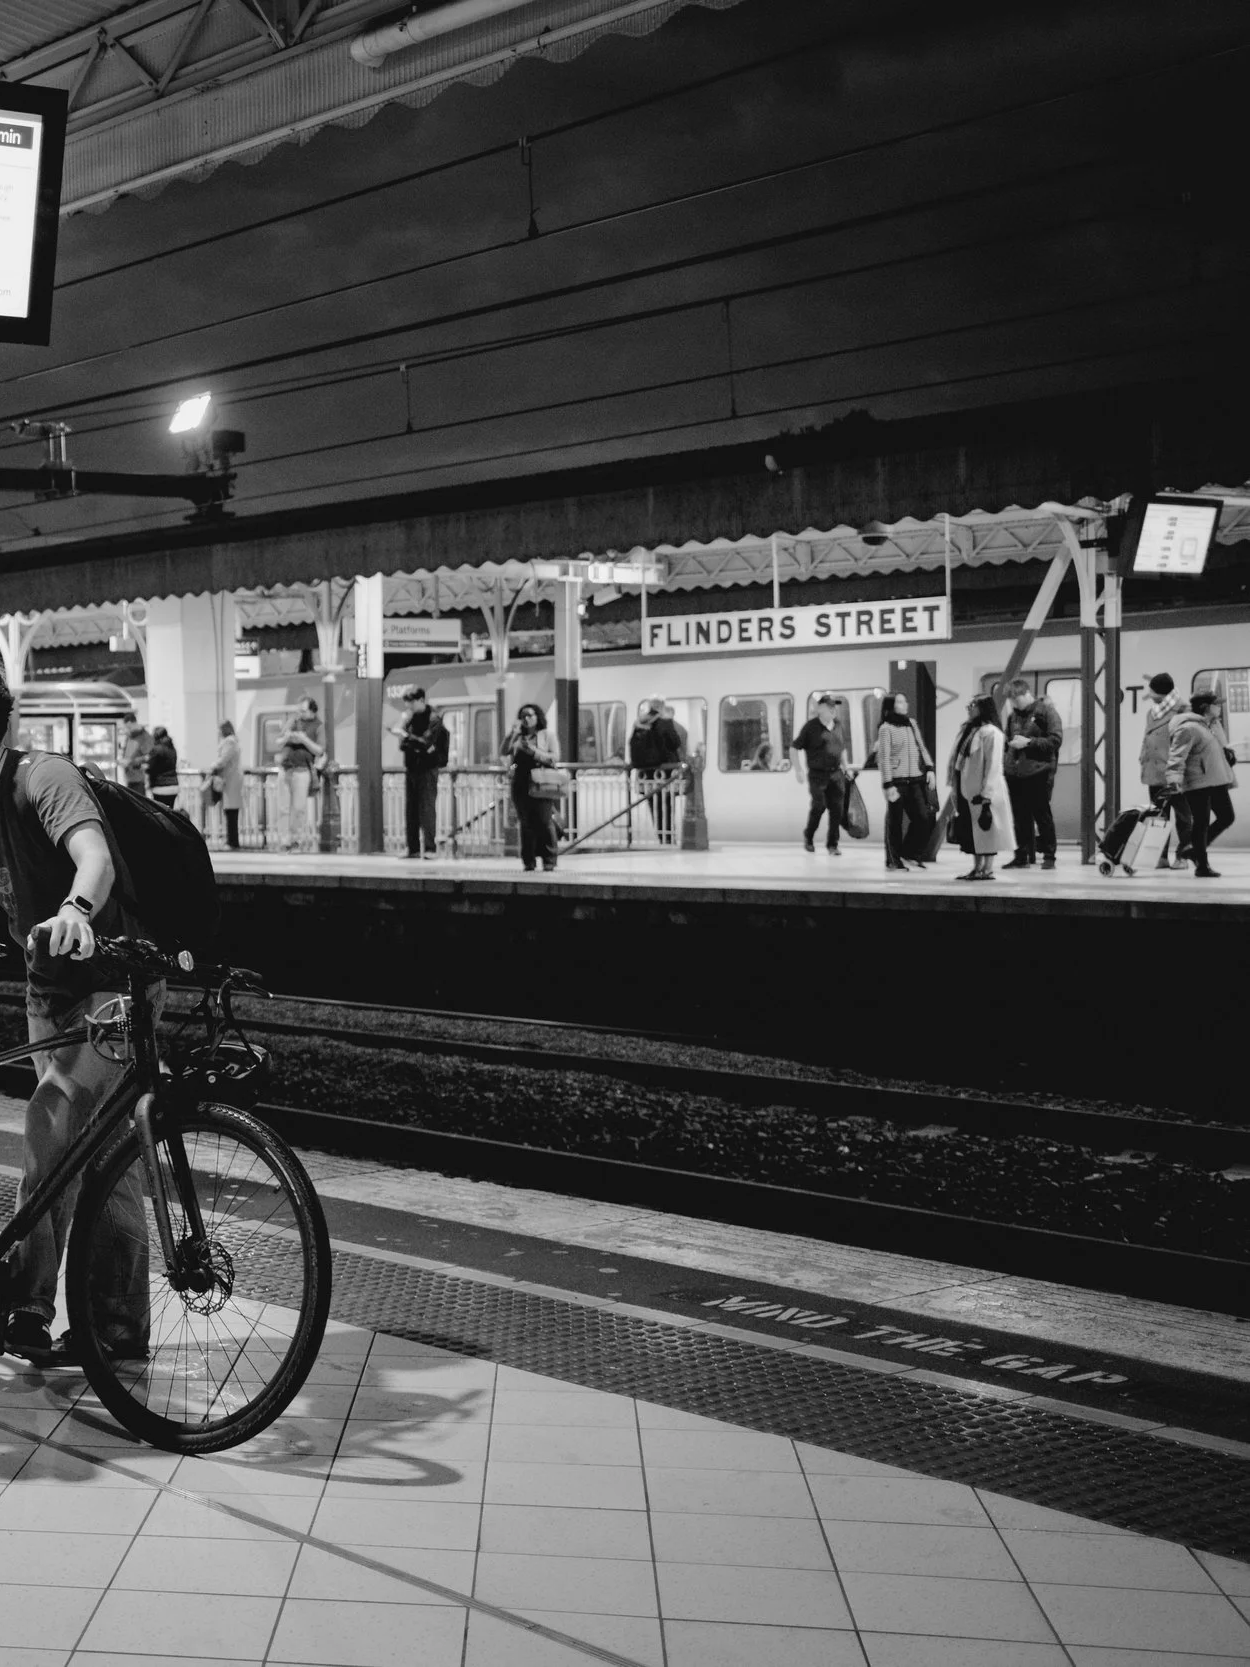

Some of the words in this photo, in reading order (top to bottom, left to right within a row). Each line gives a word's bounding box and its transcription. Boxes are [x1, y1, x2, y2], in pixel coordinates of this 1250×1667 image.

[391, 624, 431, 634] Platforms
[650, 615, 795, 647] FLINDERS
[814, 604, 940, 638] STREET
[701, 1294, 851, 1330] MIND
[853, 1325, 986, 1361] THE
[980, 1353, 1130, 1387] GAP
